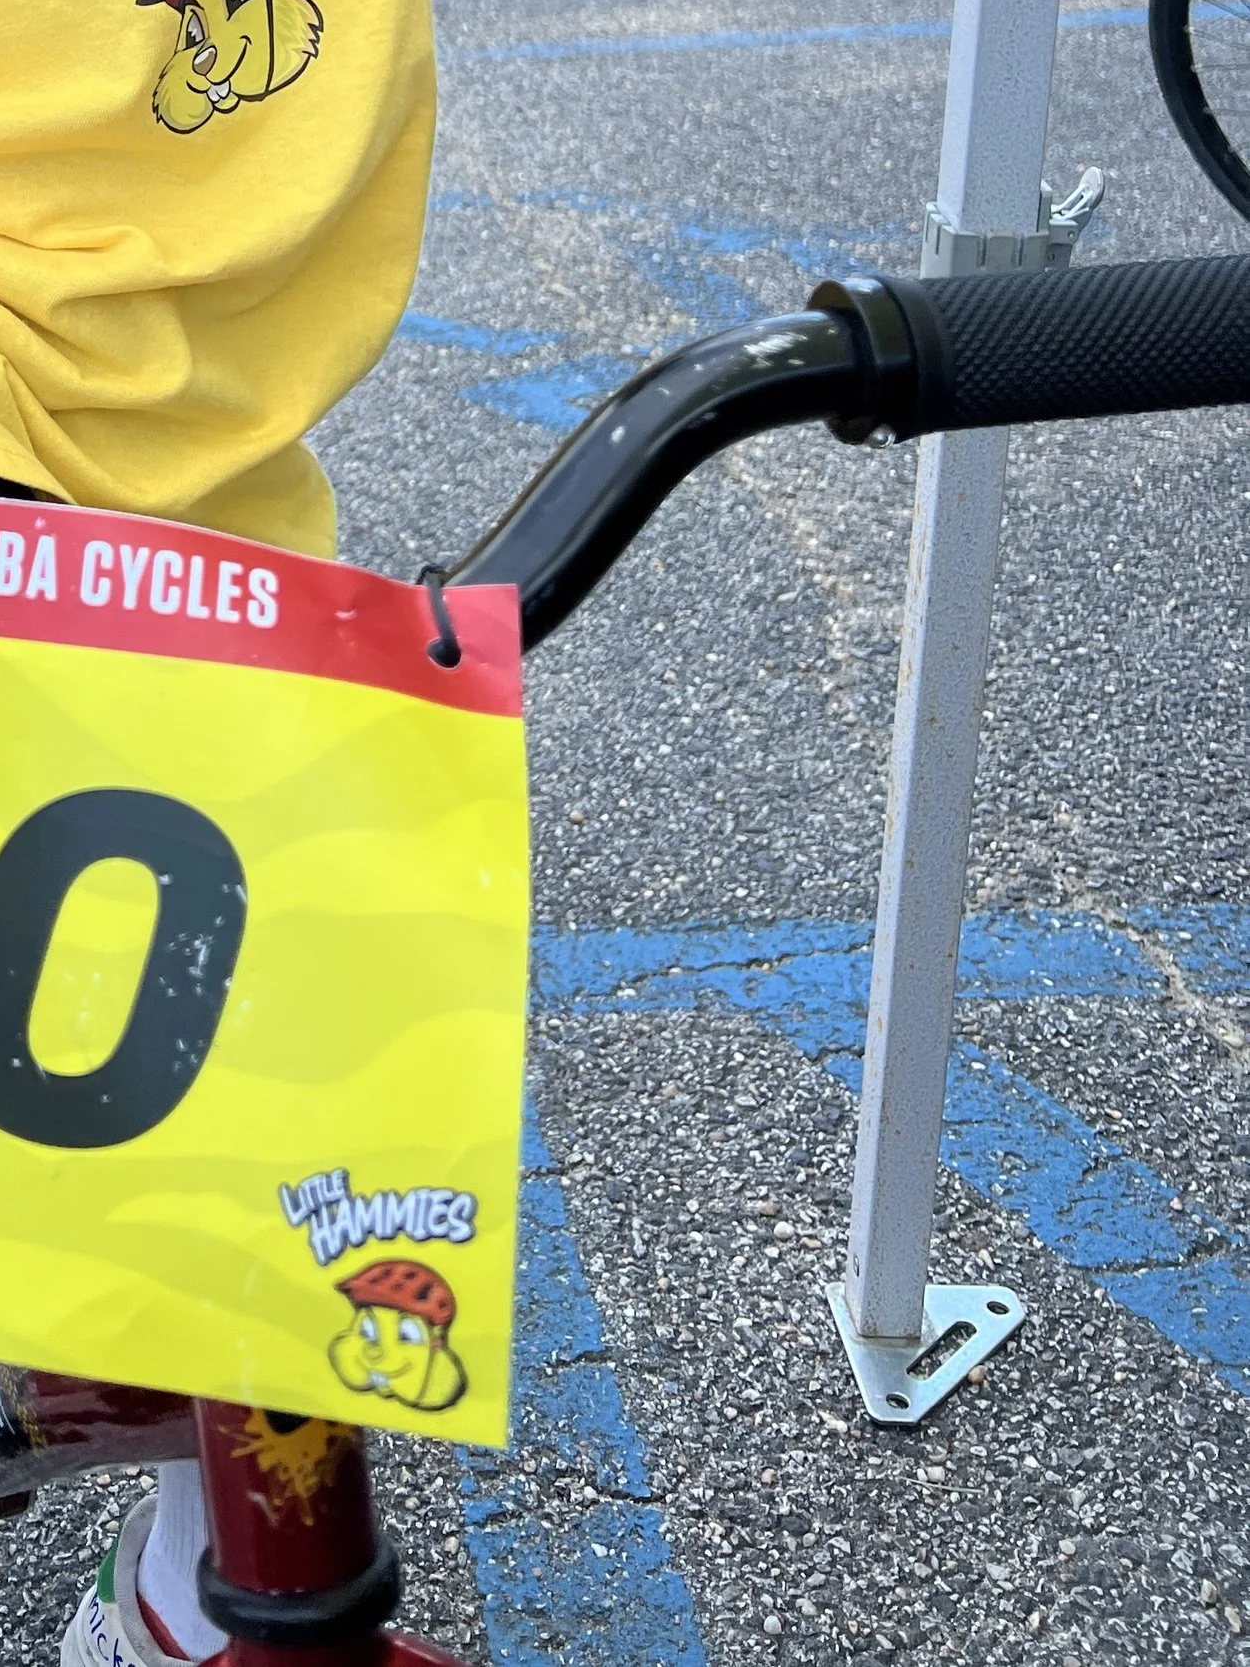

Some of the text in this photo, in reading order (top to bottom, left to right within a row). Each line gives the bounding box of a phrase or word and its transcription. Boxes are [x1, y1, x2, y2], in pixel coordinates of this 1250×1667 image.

[80, 540, 279, 630] CYCLES
[281, 1168, 348, 1227] LITTLE
[310, 1188, 476, 1266] HAMMIES
